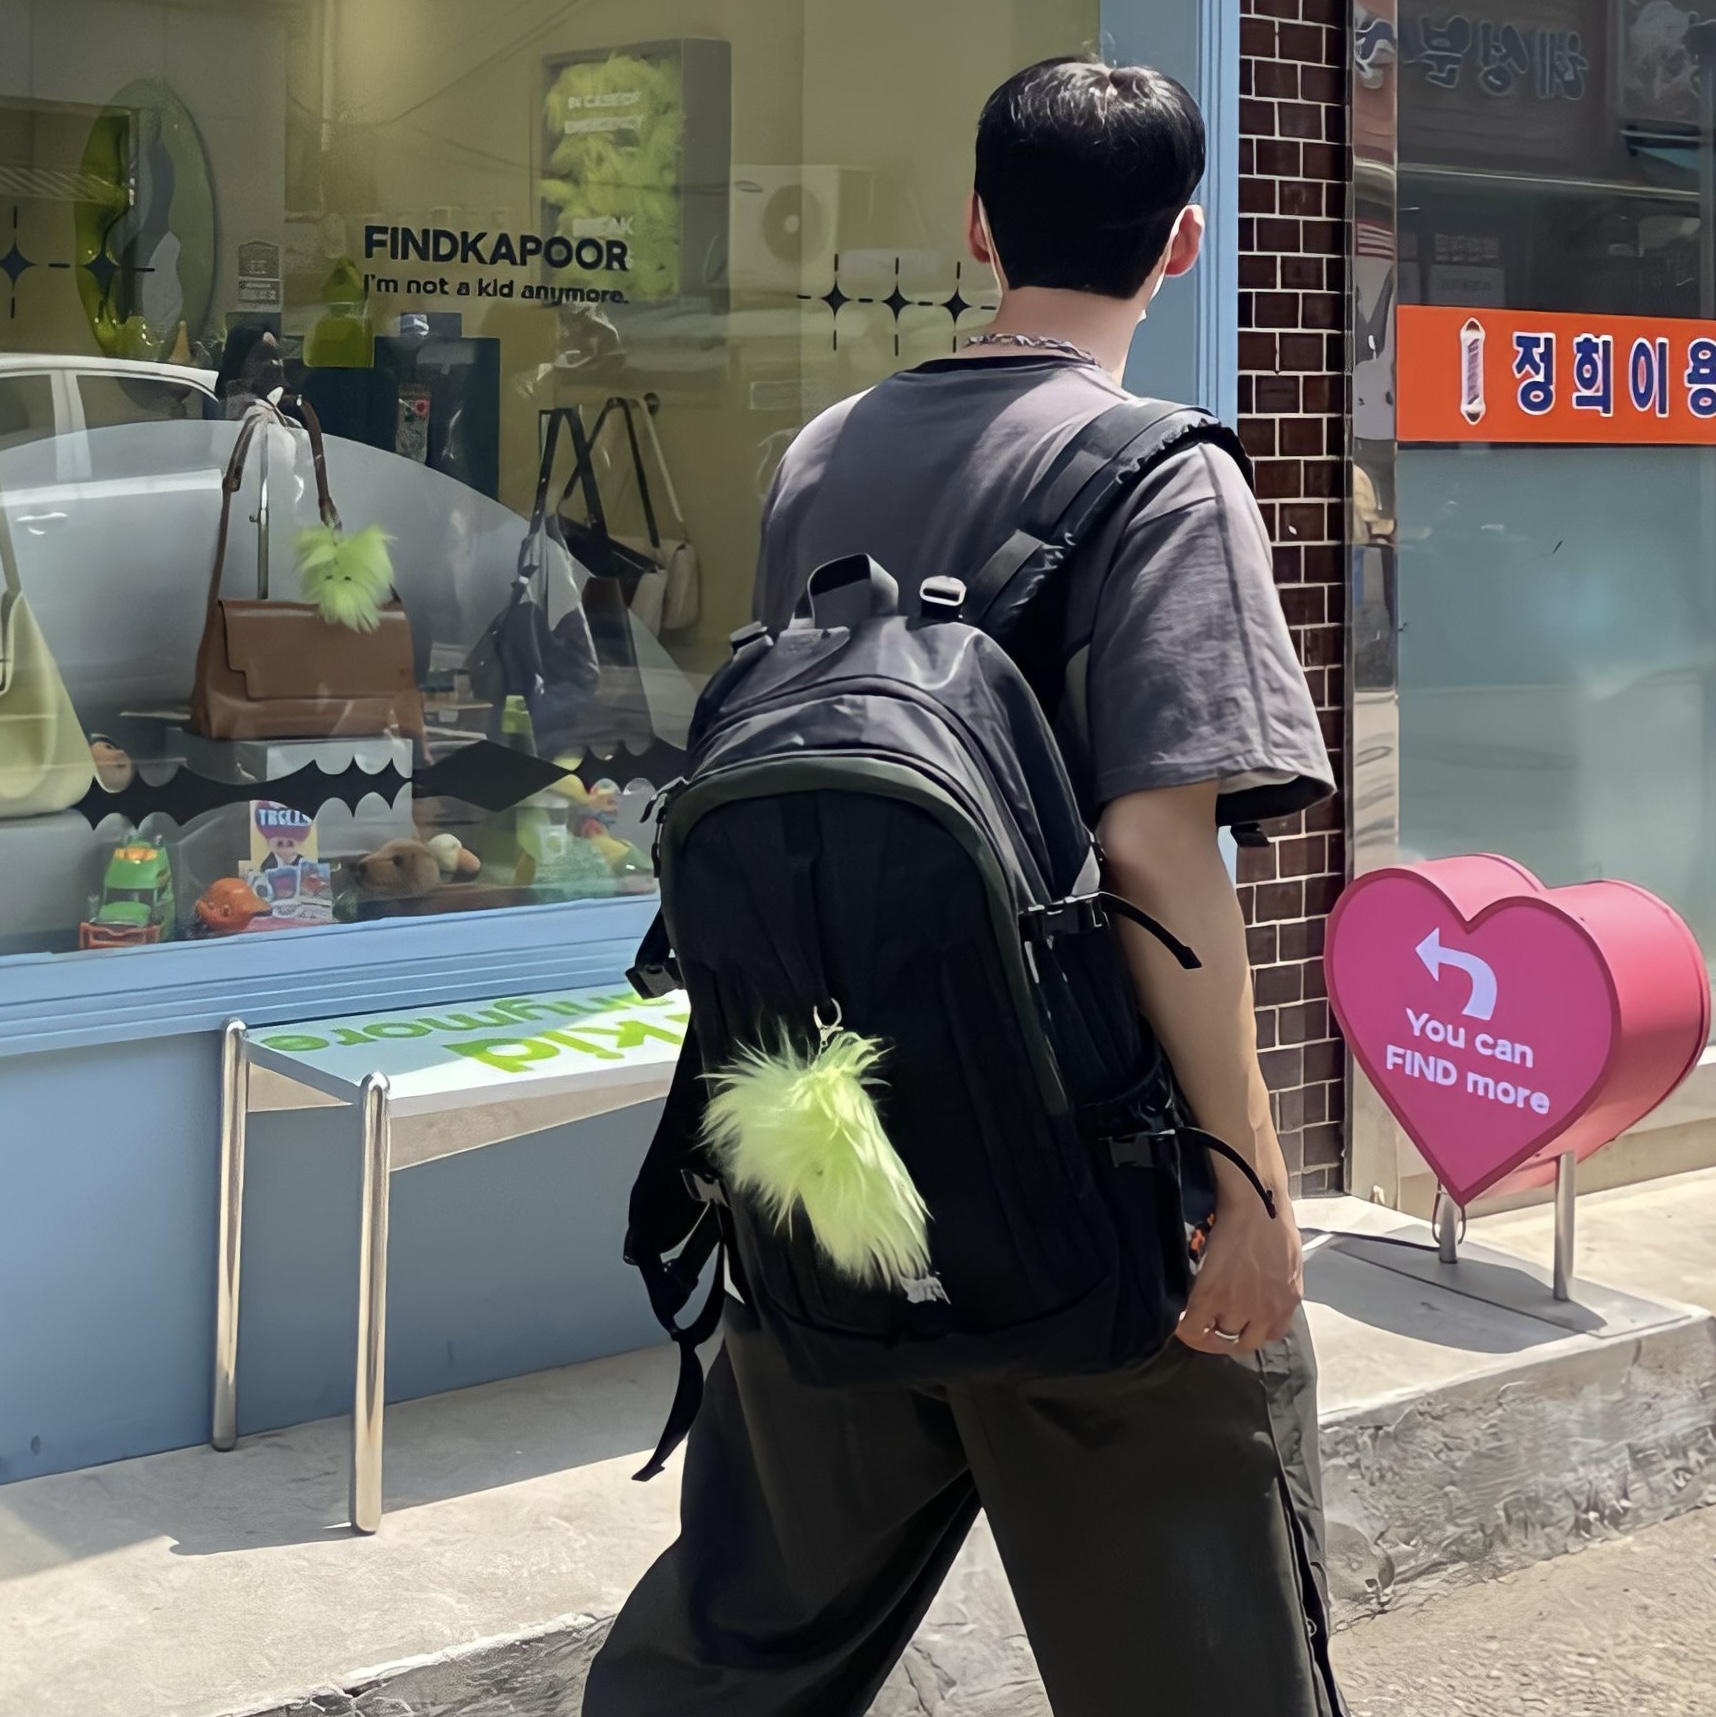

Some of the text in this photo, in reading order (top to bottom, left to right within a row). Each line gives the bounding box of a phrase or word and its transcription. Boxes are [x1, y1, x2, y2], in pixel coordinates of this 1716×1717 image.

[364, 225, 629, 271] FINDKAPOOR
[364, 274, 398, 295] I'm
[406, 276, 449, 295] not
[457, 281, 470, 296] a
[478, 278, 513, 298] kid
[1406, 1007, 1534, 1068] You can
[1386, 1044, 1550, 1114] FIND more
